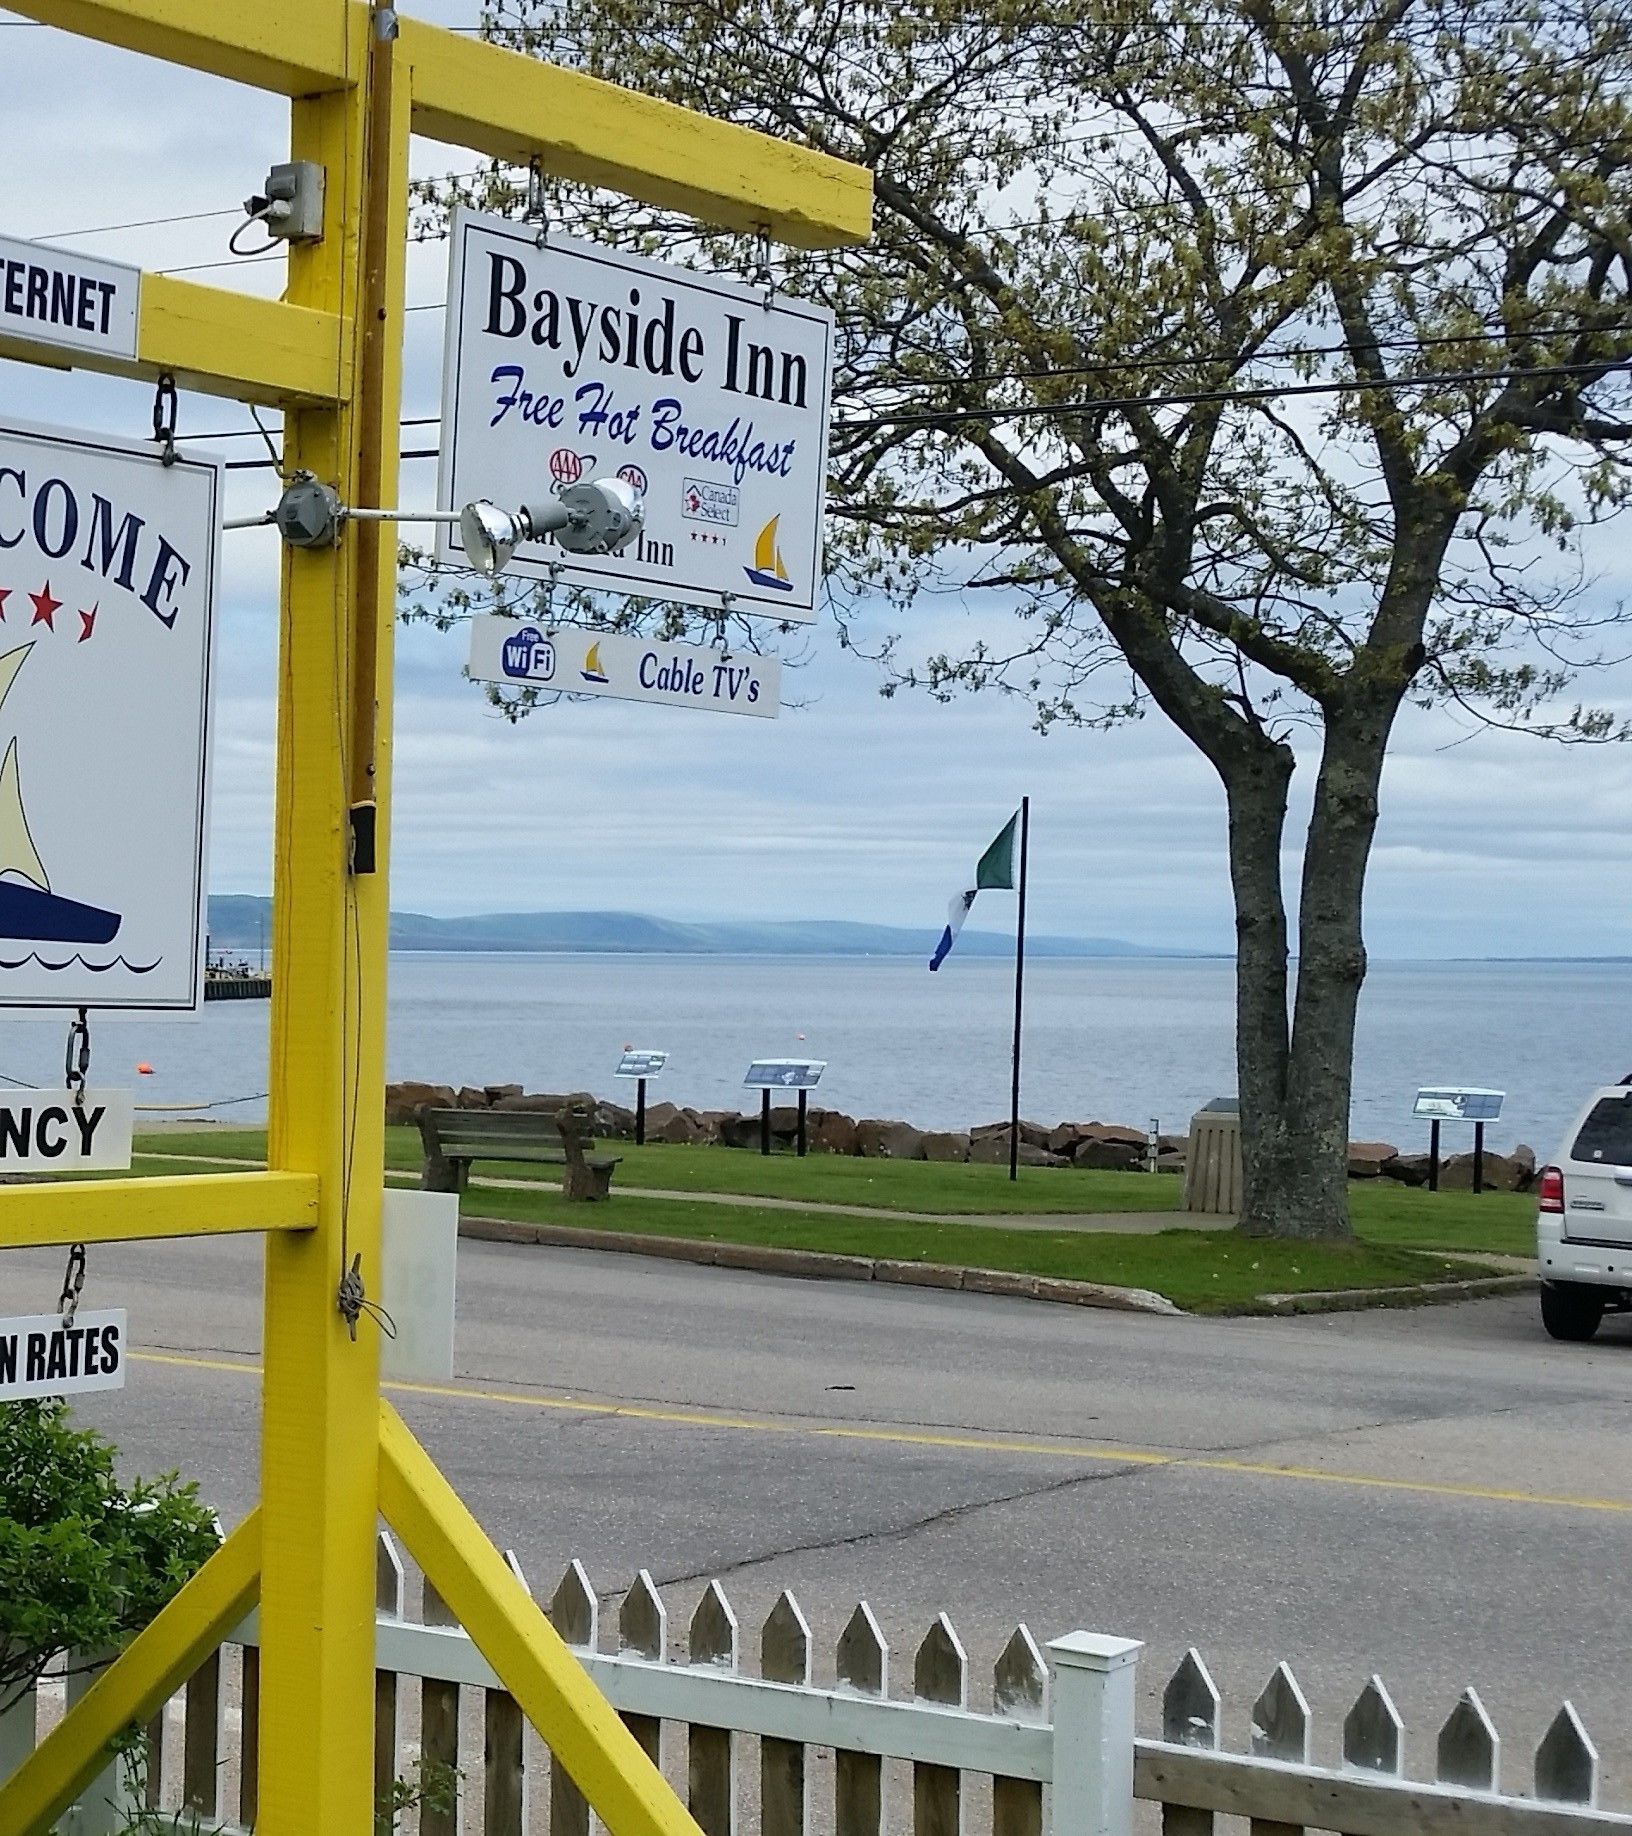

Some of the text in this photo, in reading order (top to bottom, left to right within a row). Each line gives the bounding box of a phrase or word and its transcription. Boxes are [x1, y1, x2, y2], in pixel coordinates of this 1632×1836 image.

[482, 250, 808, 409] Bayside Inn
[490, 365, 796, 485] Free Hot Breakfast
[552, 450, 582, 483] AAA
[701, 502, 730, 522] Select
[702, 486, 737, 506] Canada
[636, 529, 675, 567] Inn
[639, 651, 761, 703] Cable TV's
[25, 1324, 120, 1382] RATES
